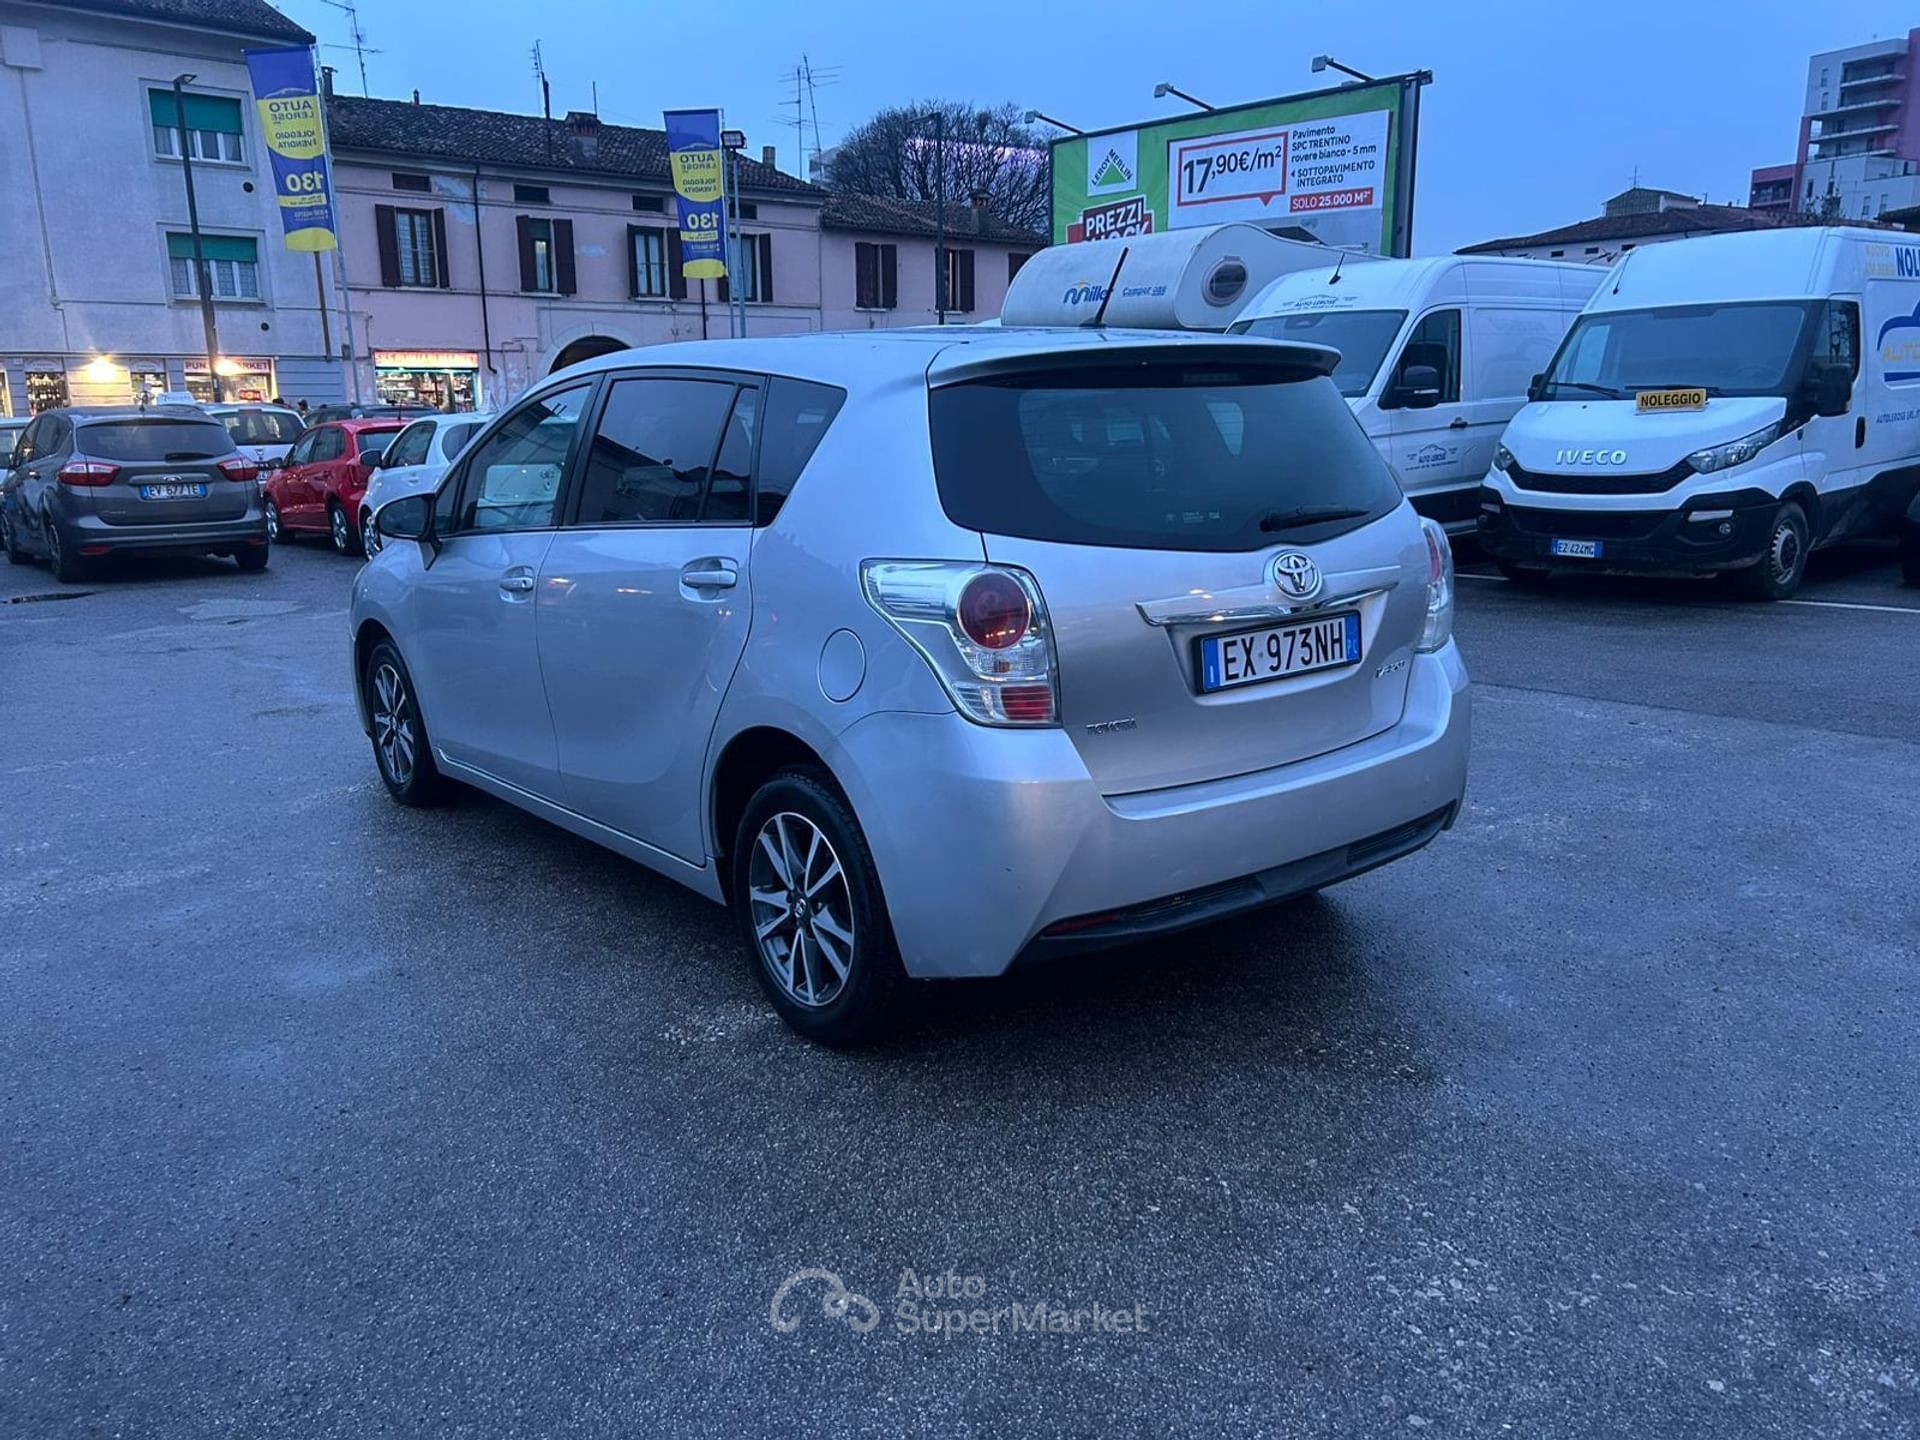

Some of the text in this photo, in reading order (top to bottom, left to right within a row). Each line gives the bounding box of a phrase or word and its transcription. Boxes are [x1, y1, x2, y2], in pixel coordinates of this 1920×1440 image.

[1293, 126, 1335, 140] Pavimento
[1292, 135, 1351, 151] SPC TRENTINO
[1291, 152, 1318, 163] rovere
[1319, 149, 1346, 159] bianco
[1352, 146, 1358, 155] 5
[1360, 145, 1376, 154] mm
[1091, 155, 1110, 186] LEROY
[1108, 148, 1133, 181] MERLIN
[1297, 160, 1375, 177] SOTTOPAVIMENTO
[1297, 174, 1344, 188] INTEGRATO
[1292, 196, 1317, 209] SOLO
[1318, 193, 1352, 206] 25.000
[1086, 201, 1142, 237] PREZZI
[1895, 247, 1920, 277] NOL
[1640, 392, 1701, 407] NOLEGGIO
[1556, 449, 1627, 465] IVECO
[1223, 637, 1256, 681] EX
[1267, 621, 1344, 672] 973NH
